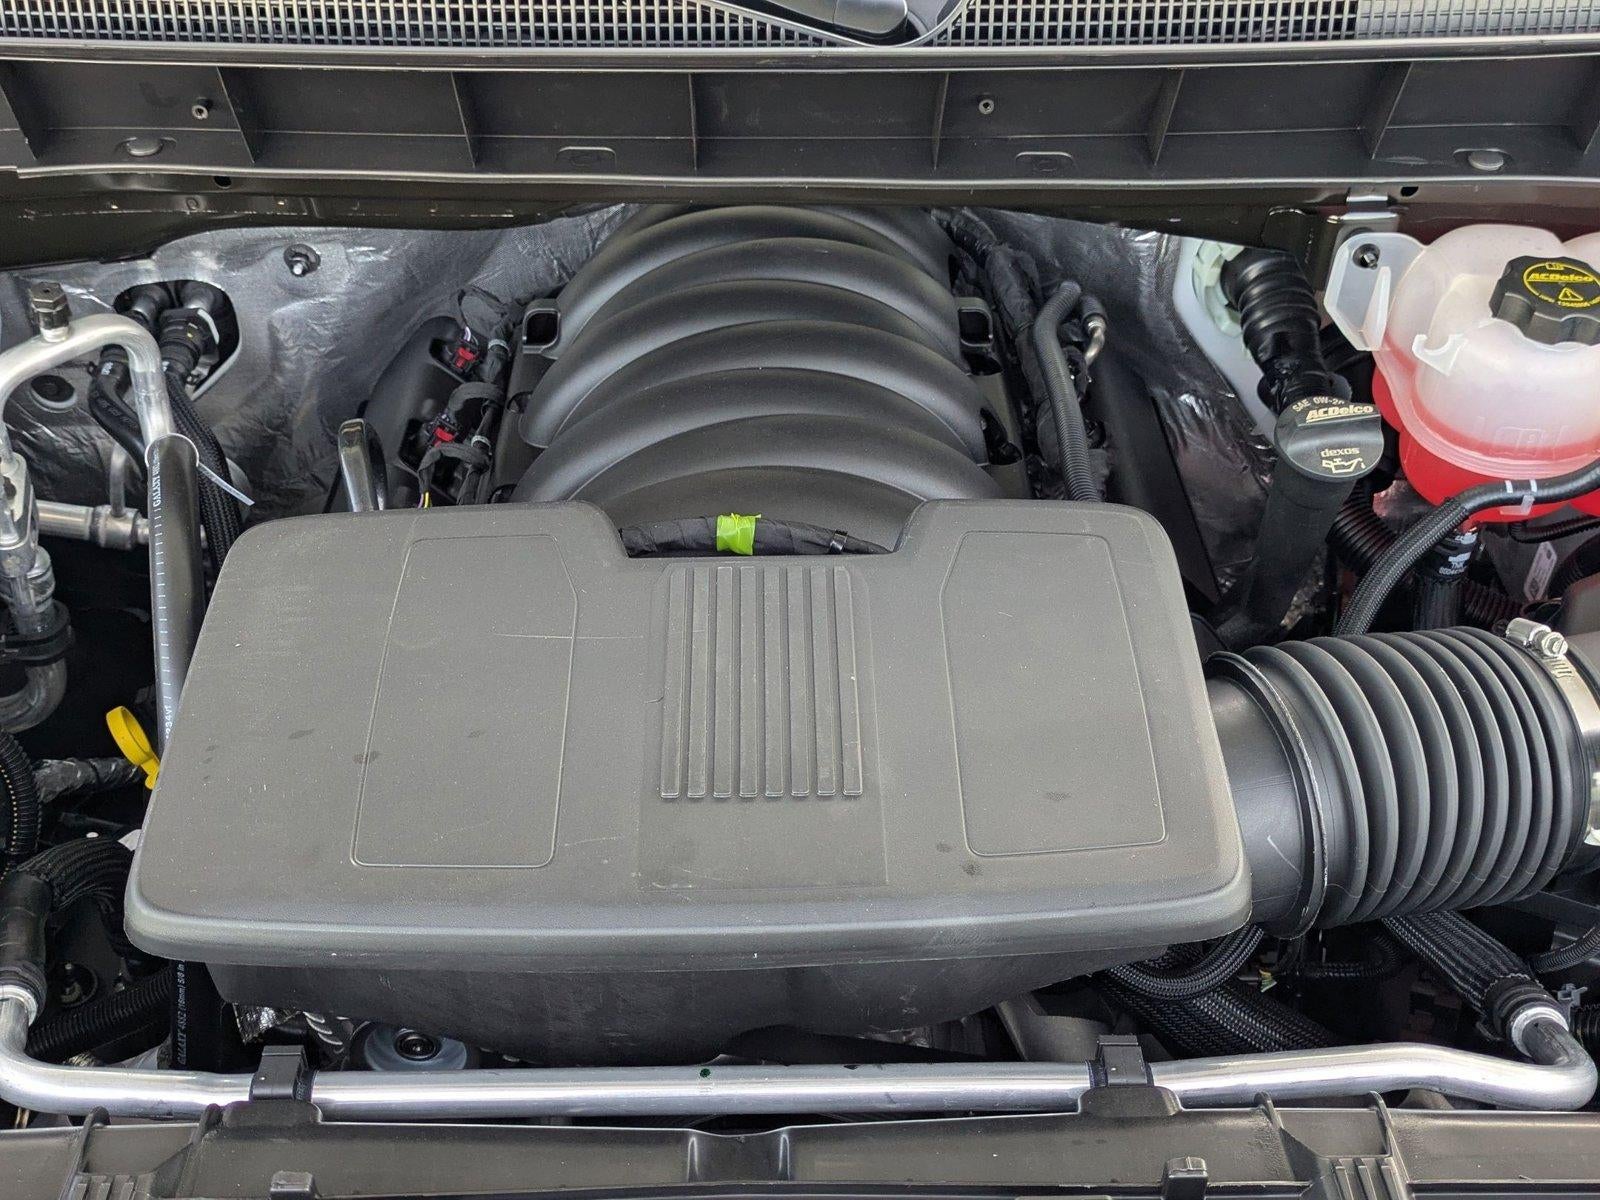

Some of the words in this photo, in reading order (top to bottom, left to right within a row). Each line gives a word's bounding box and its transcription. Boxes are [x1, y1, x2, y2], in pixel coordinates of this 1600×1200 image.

[1526, 272, 1594, 282] ACDelco
[1292, 398, 1312, 412] SAE
[1305, 404, 1374, 423] ACDelco
[1320, 447, 1361, 458] dexos
[152, 475, 161, 508] GALAXY
